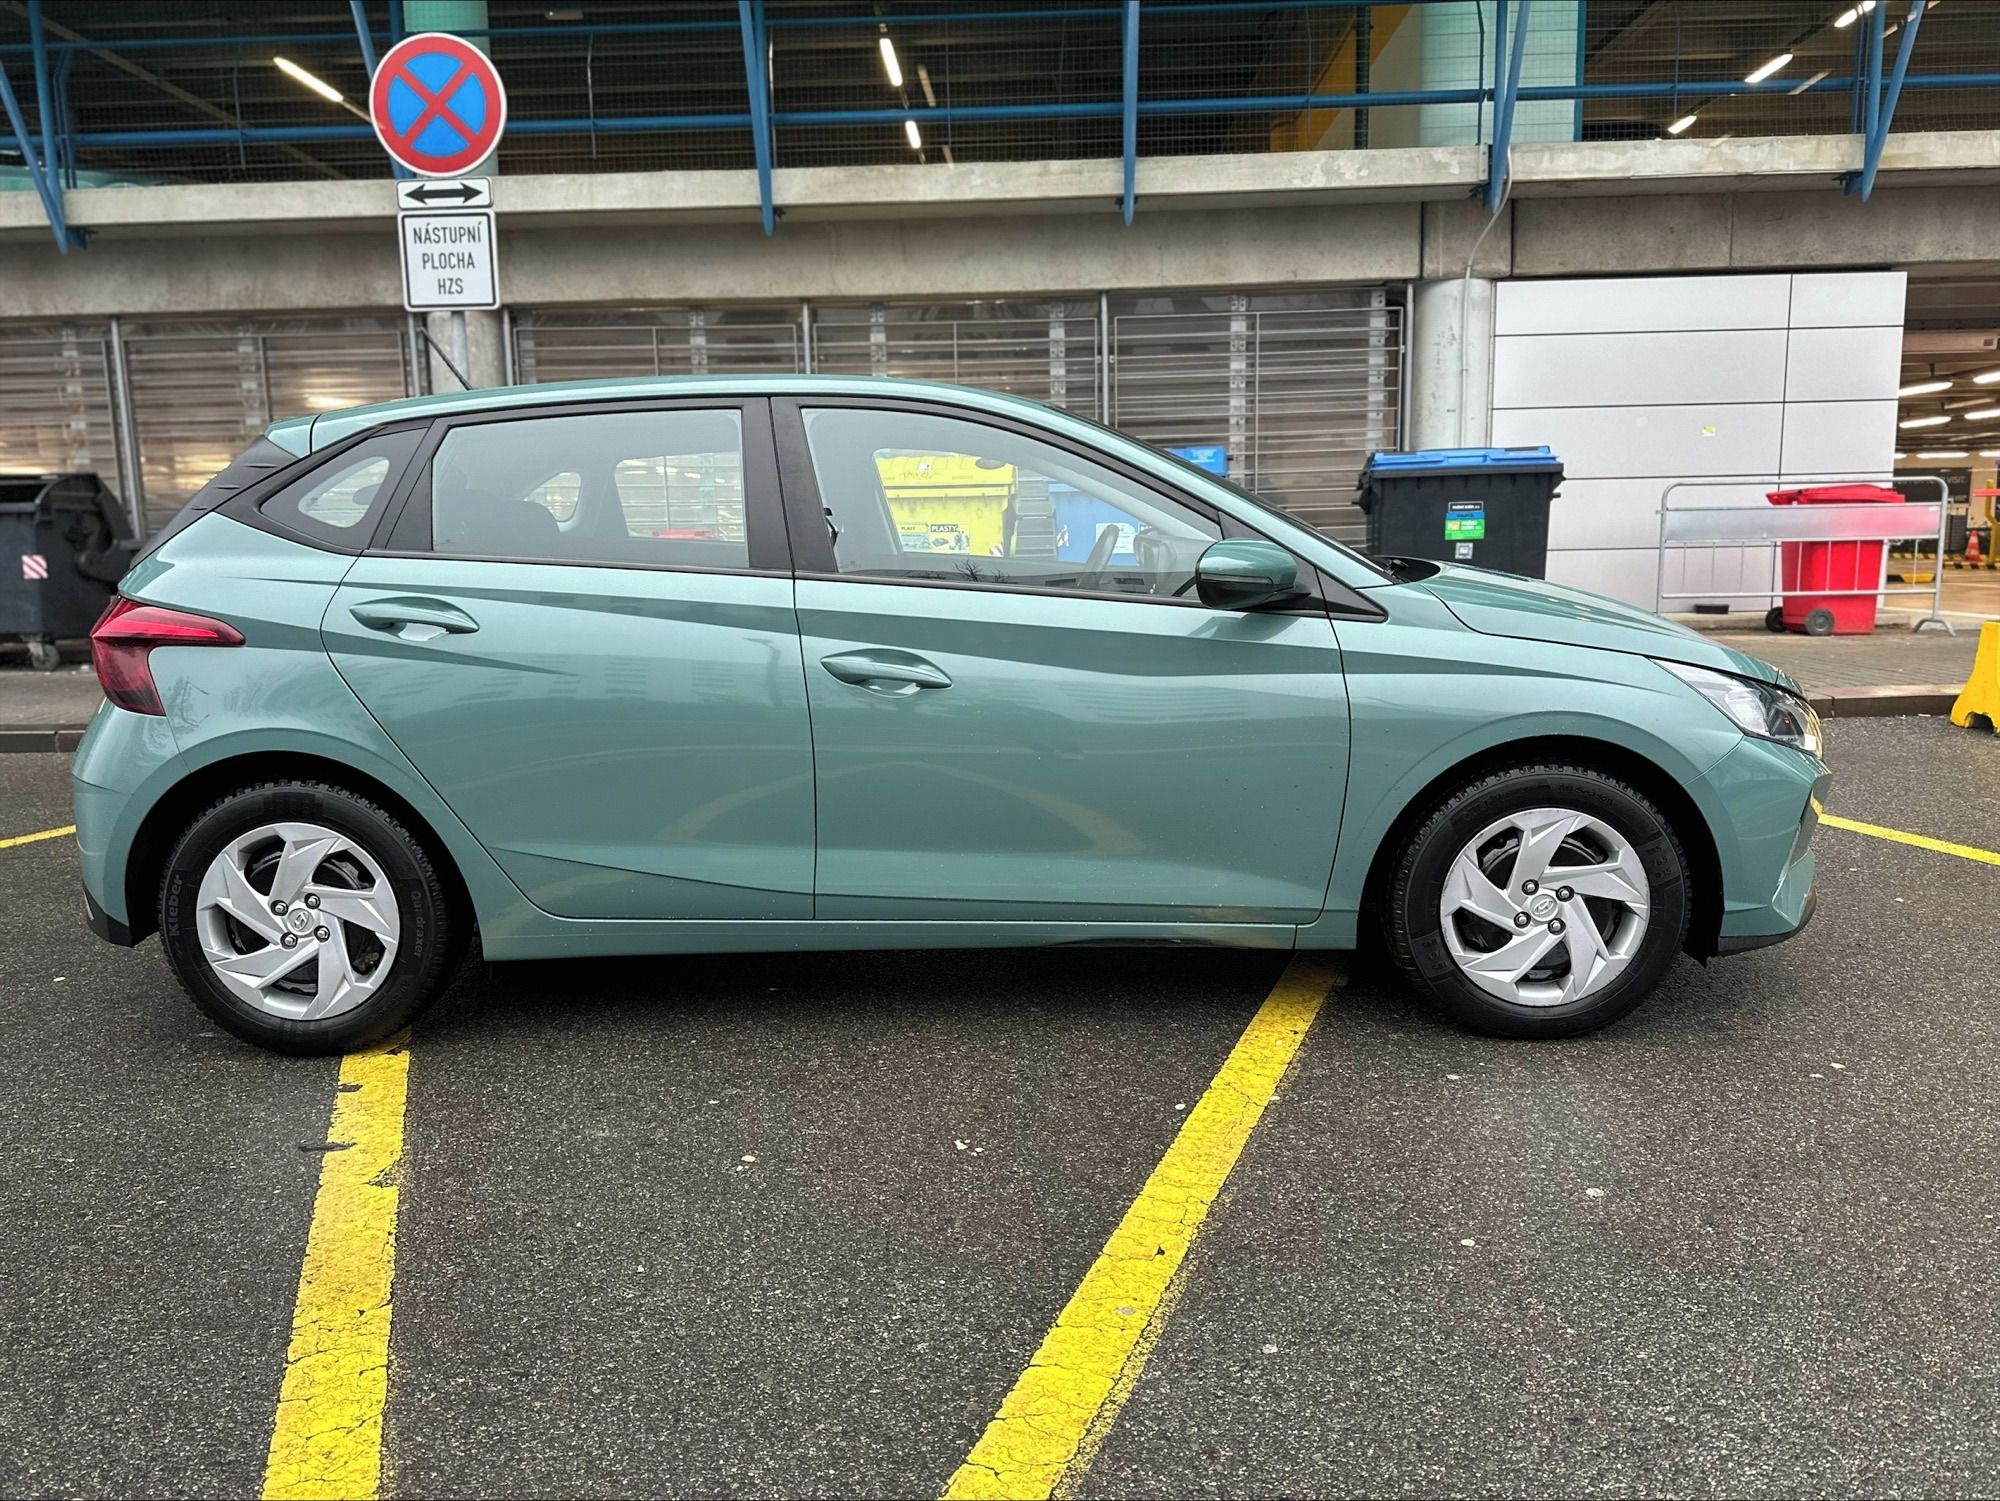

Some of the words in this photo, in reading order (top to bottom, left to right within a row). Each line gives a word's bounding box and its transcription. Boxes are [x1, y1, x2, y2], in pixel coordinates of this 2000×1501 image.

[413, 221, 481, 244] NÁSTUPNÍ
[422, 252, 475, 269] PLOCHA
[438, 278, 463, 295] HZS
[168, 874, 183, 937] Kleber
